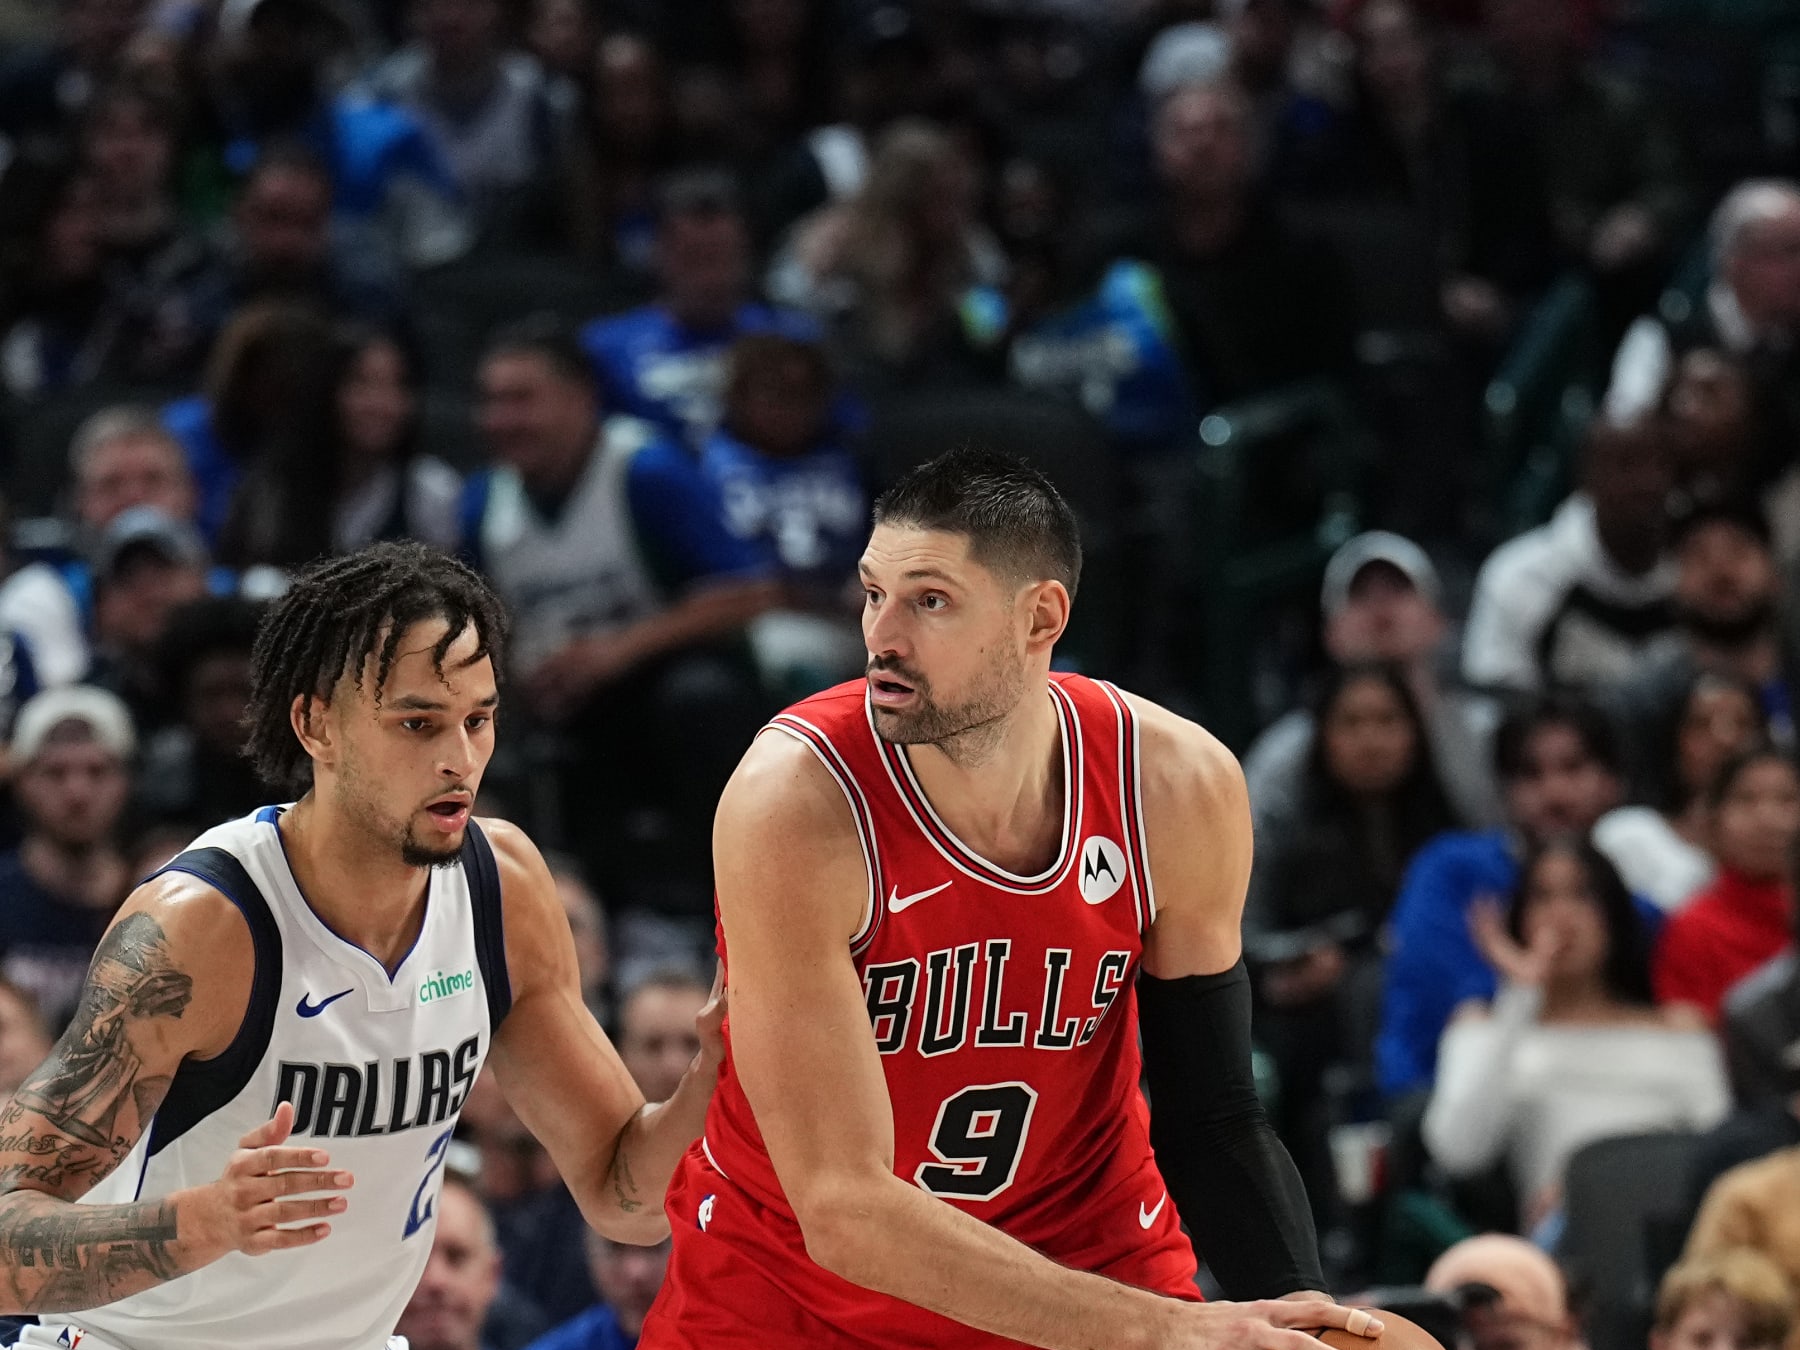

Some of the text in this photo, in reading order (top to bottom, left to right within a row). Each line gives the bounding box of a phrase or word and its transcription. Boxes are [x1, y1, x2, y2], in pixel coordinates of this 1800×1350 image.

[419, 970, 473, 1003] chime
[864, 938, 1131, 1058] BULLS
[269, 1033, 479, 1138] DALLAS
[914, 1081, 1038, 1201] 9
[402, 1126, 454, 1241] 2
